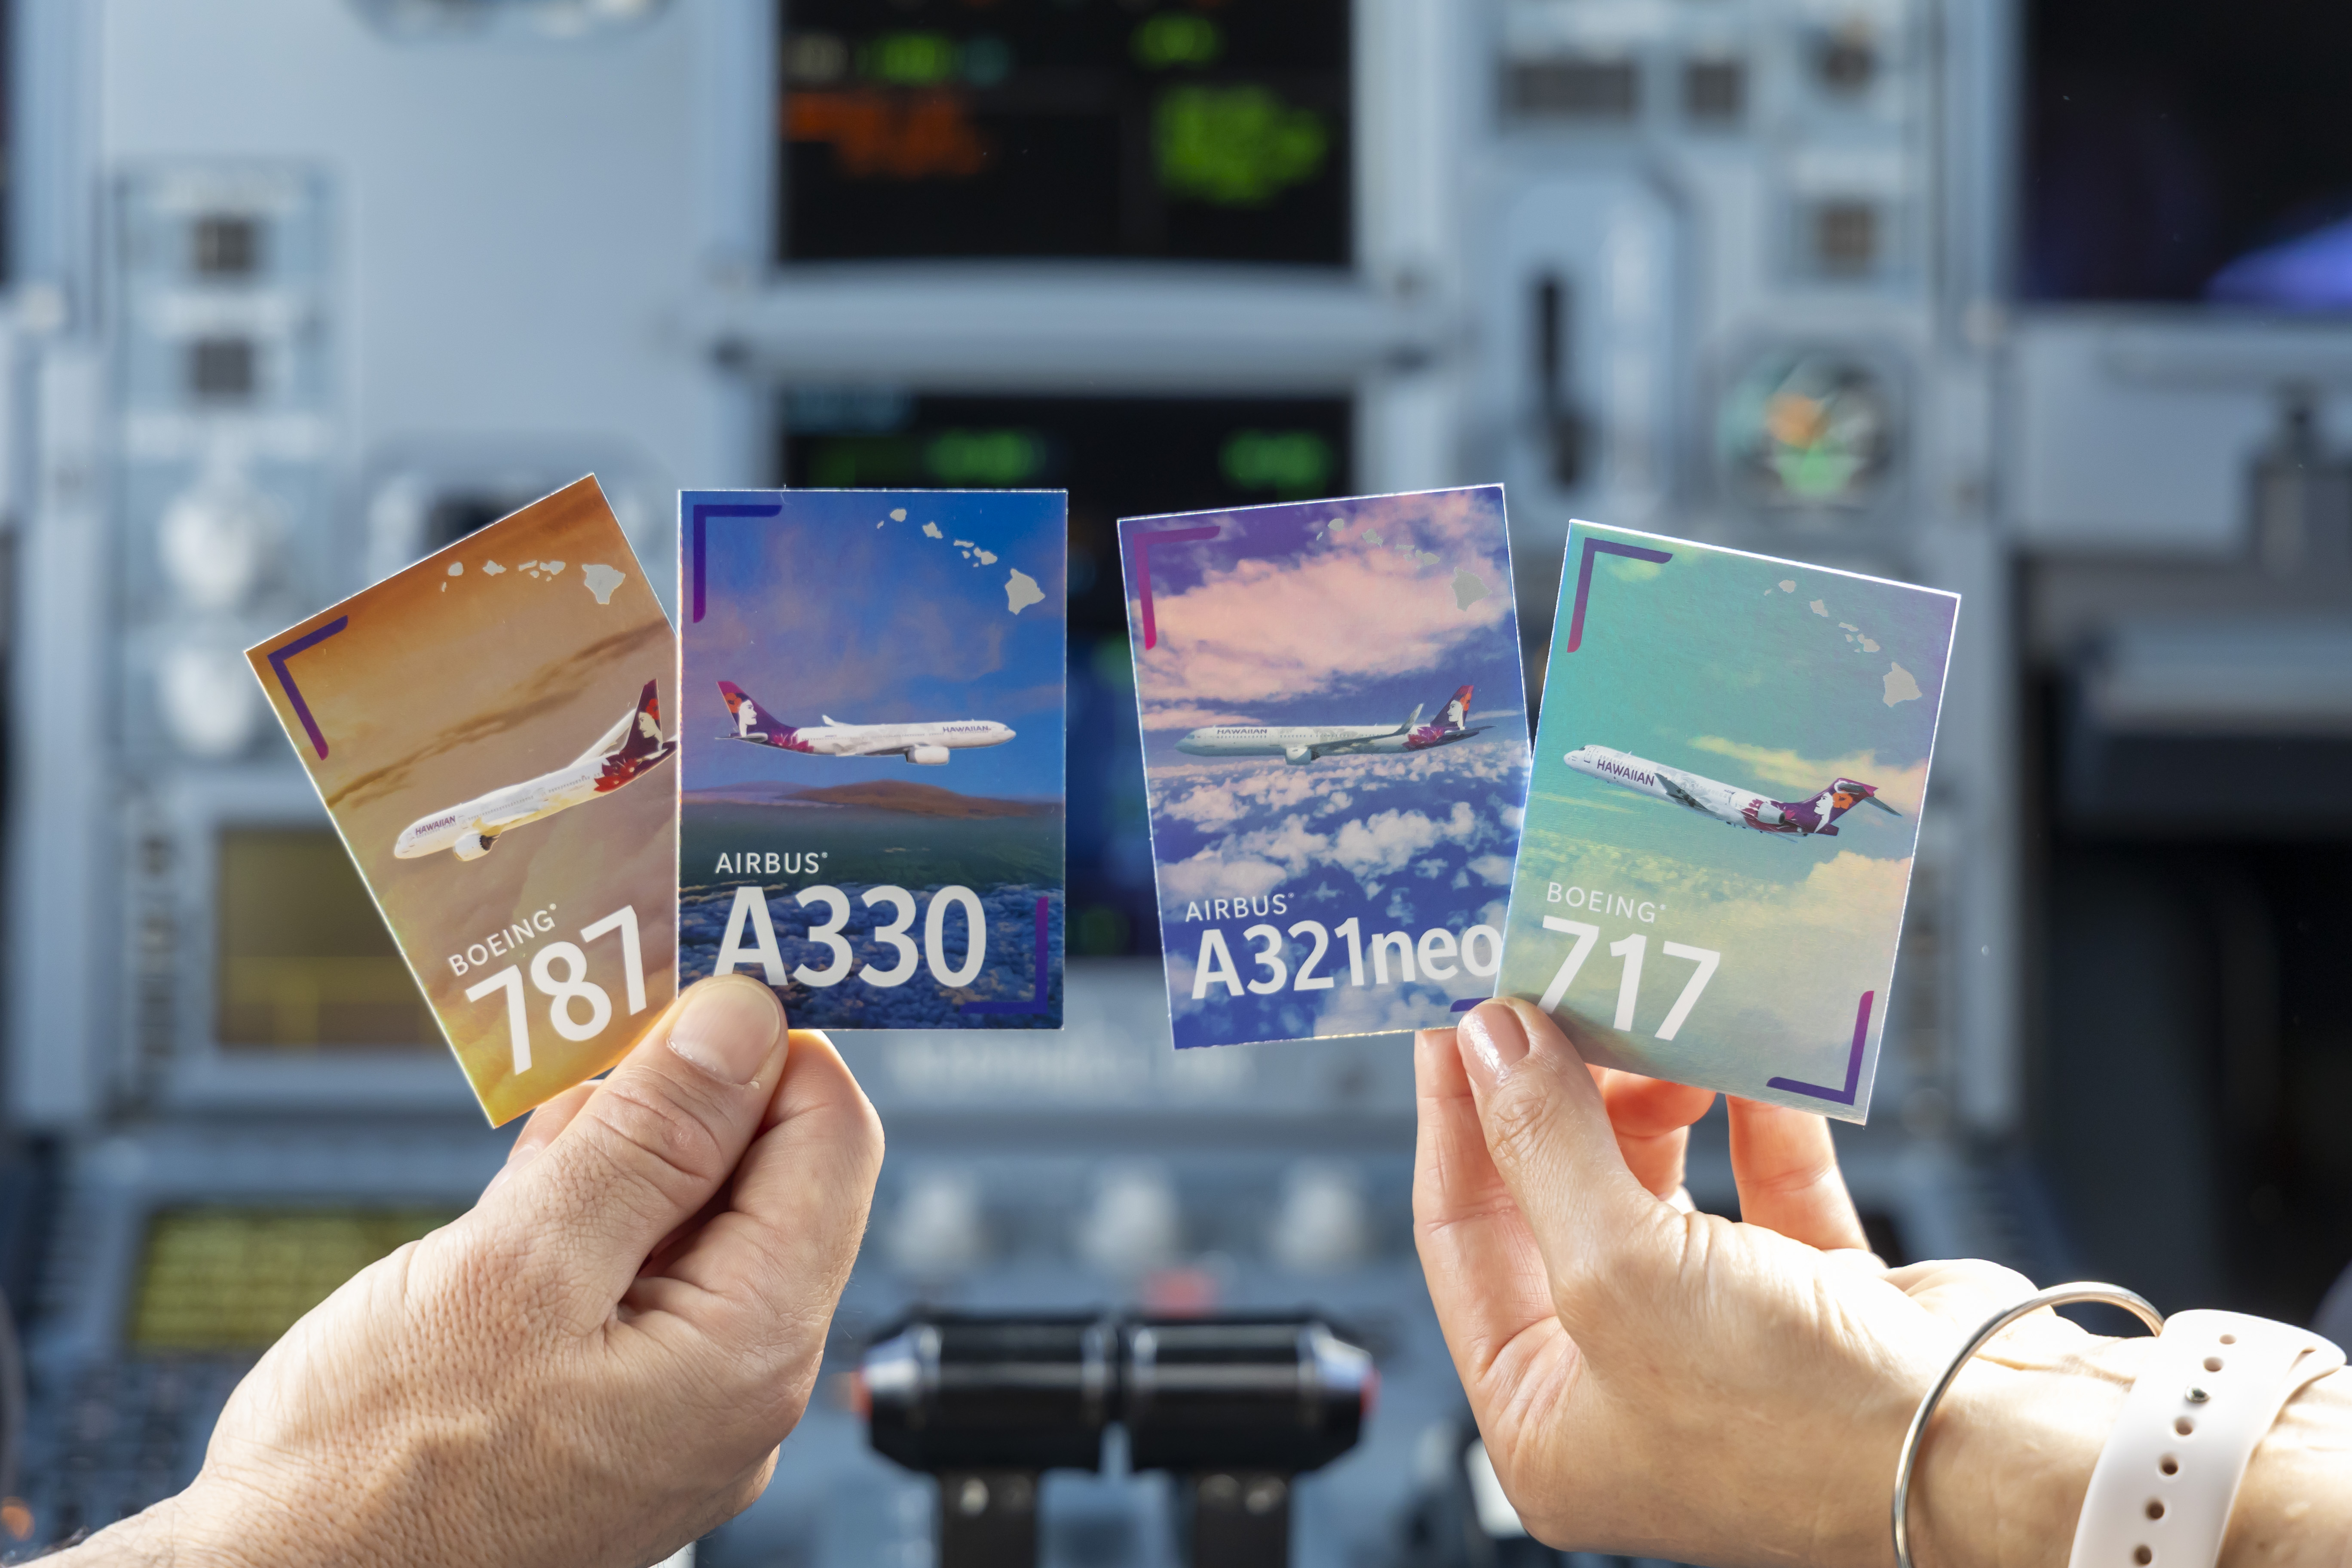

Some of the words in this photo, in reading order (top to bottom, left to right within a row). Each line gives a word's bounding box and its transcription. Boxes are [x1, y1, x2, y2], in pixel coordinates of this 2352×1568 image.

[1597, 759, 1654, 786] HAWAIIAN
[415, 815, 456, 836] HAWAIIAN
[713, 884, 987, 987] A330
[1191, 916, 1502, 999] A321neo
[1537, 915, 1720, 1041] 717
[465, 904, 647, 1075] 787
